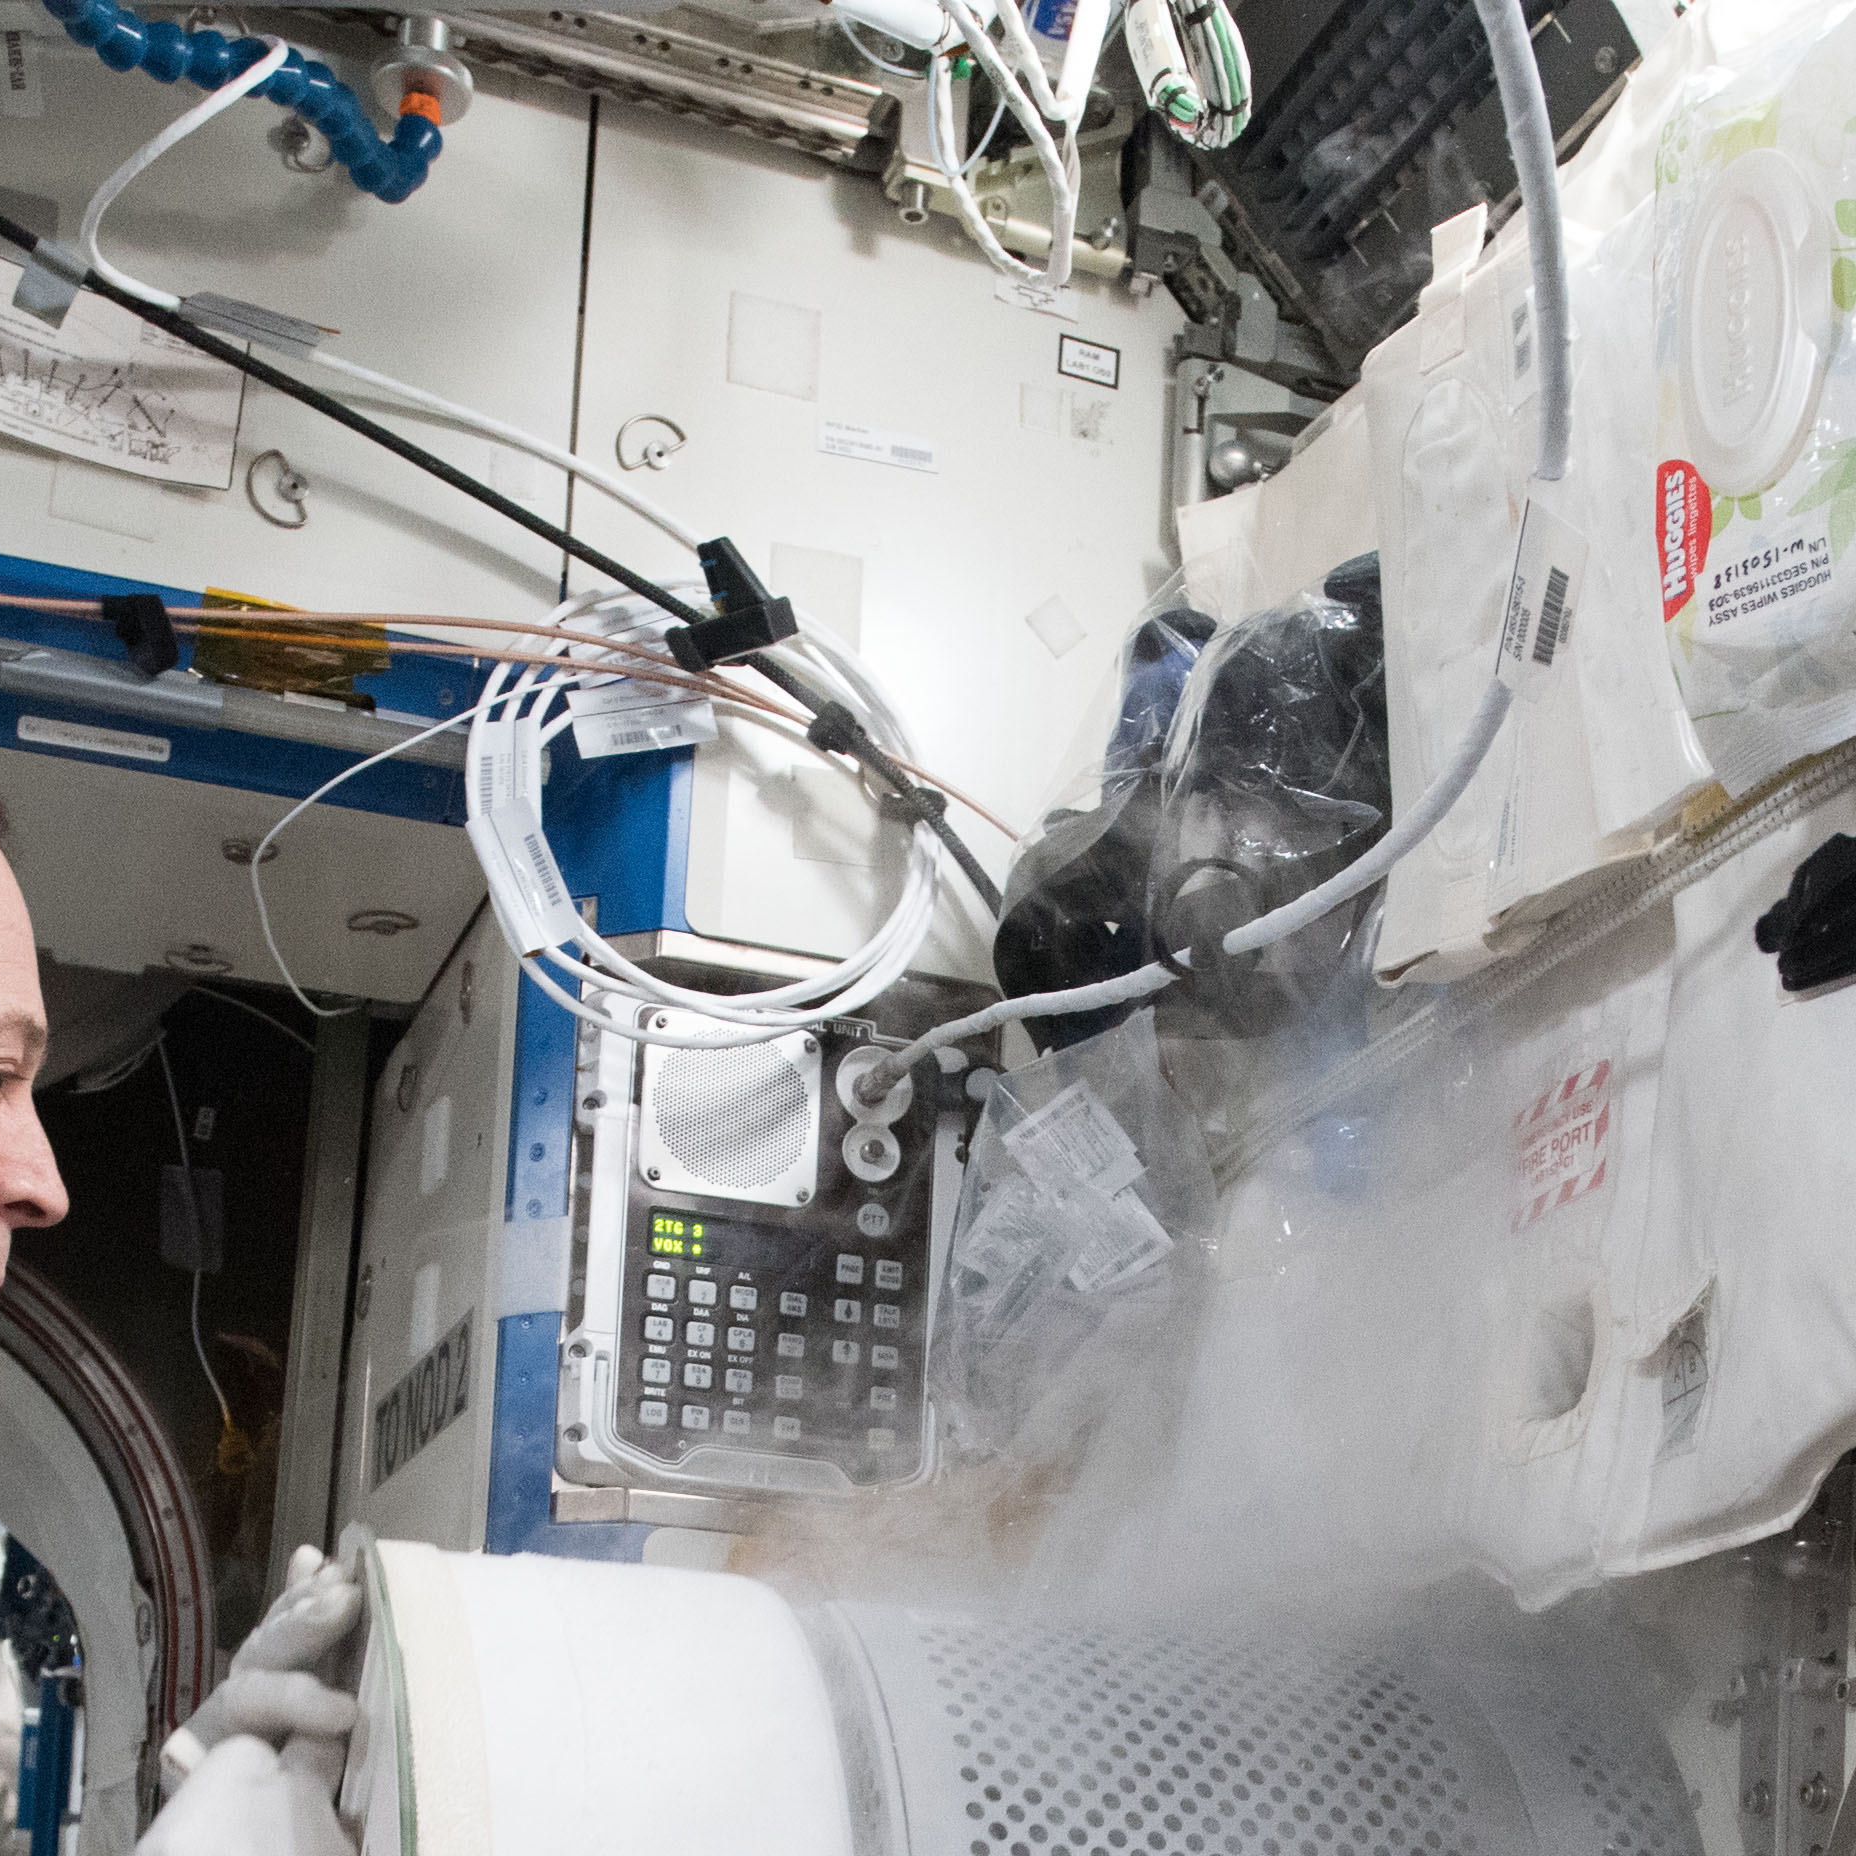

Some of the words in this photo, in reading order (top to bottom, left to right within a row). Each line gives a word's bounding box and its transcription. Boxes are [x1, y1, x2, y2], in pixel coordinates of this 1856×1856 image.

[1688, 475, 1700, 537] lingettes
[1663, 468, 1688, 602] HUGGIES
[1811, 552, 1830, 571] P/N
[1780, 568, 1832, 600] HUGGIES
[1742, 587, 1779, 614] WIPES
[1708, 607, 1739, 628] ASSY
[833, 1023, 863, 1038] UNIT
[1571, 1101, 1593, 1121] USE
[1551, 1119, 1593, 1158] PORT
[654, 1218, 684, 1235] 2TG
[692, 1223, 703, 1239] 3
[653, 1237, 683, 1254] VOX
[687, 1349, 698, 1358] EX
[699, 1351, 711, 1359] ON
[728, 1355, 738, 1363] EX
[739, 1356, 753, 1364] OFF
